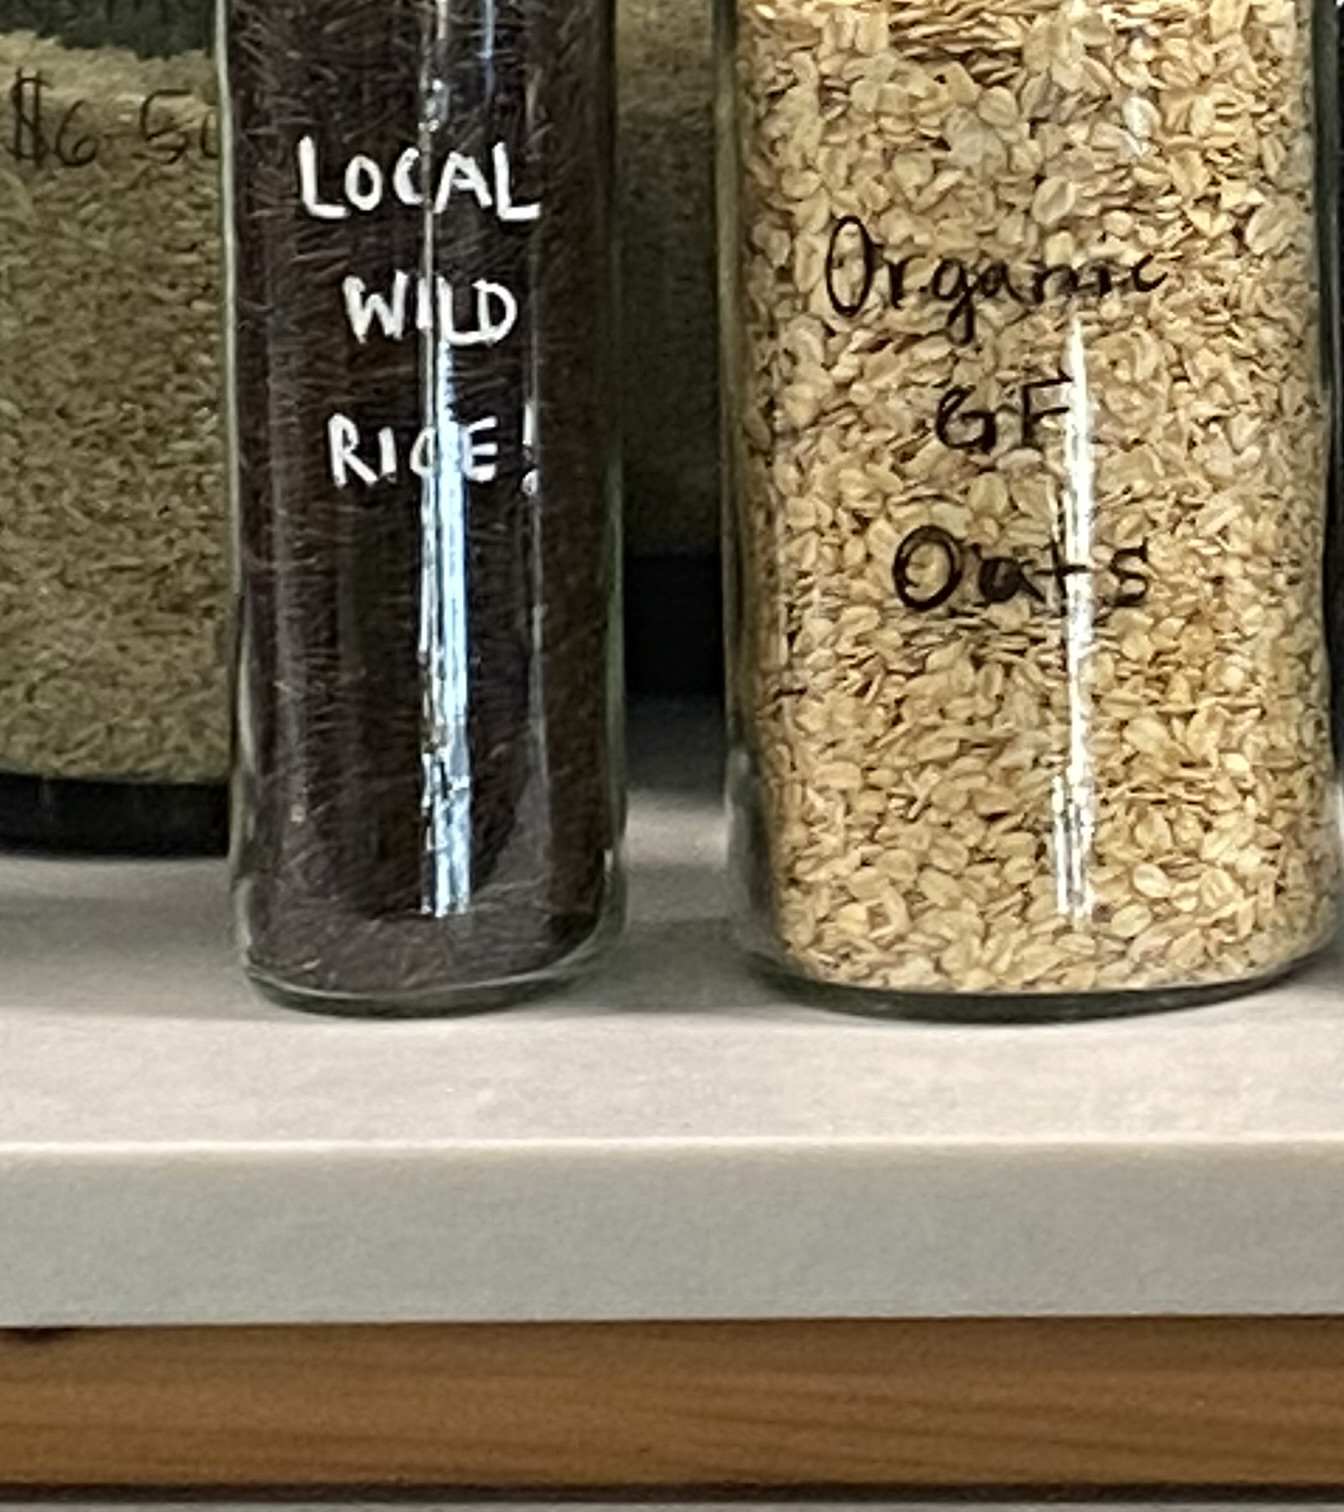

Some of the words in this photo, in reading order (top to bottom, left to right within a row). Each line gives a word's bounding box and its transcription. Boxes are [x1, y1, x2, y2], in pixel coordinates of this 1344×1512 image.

[299, 135, 542, 221] LOCAL
[342, 268, 518, 346] WILD
[327, 402, 540, 496] RICE!
[892, 492, 1148, 612] Oats
